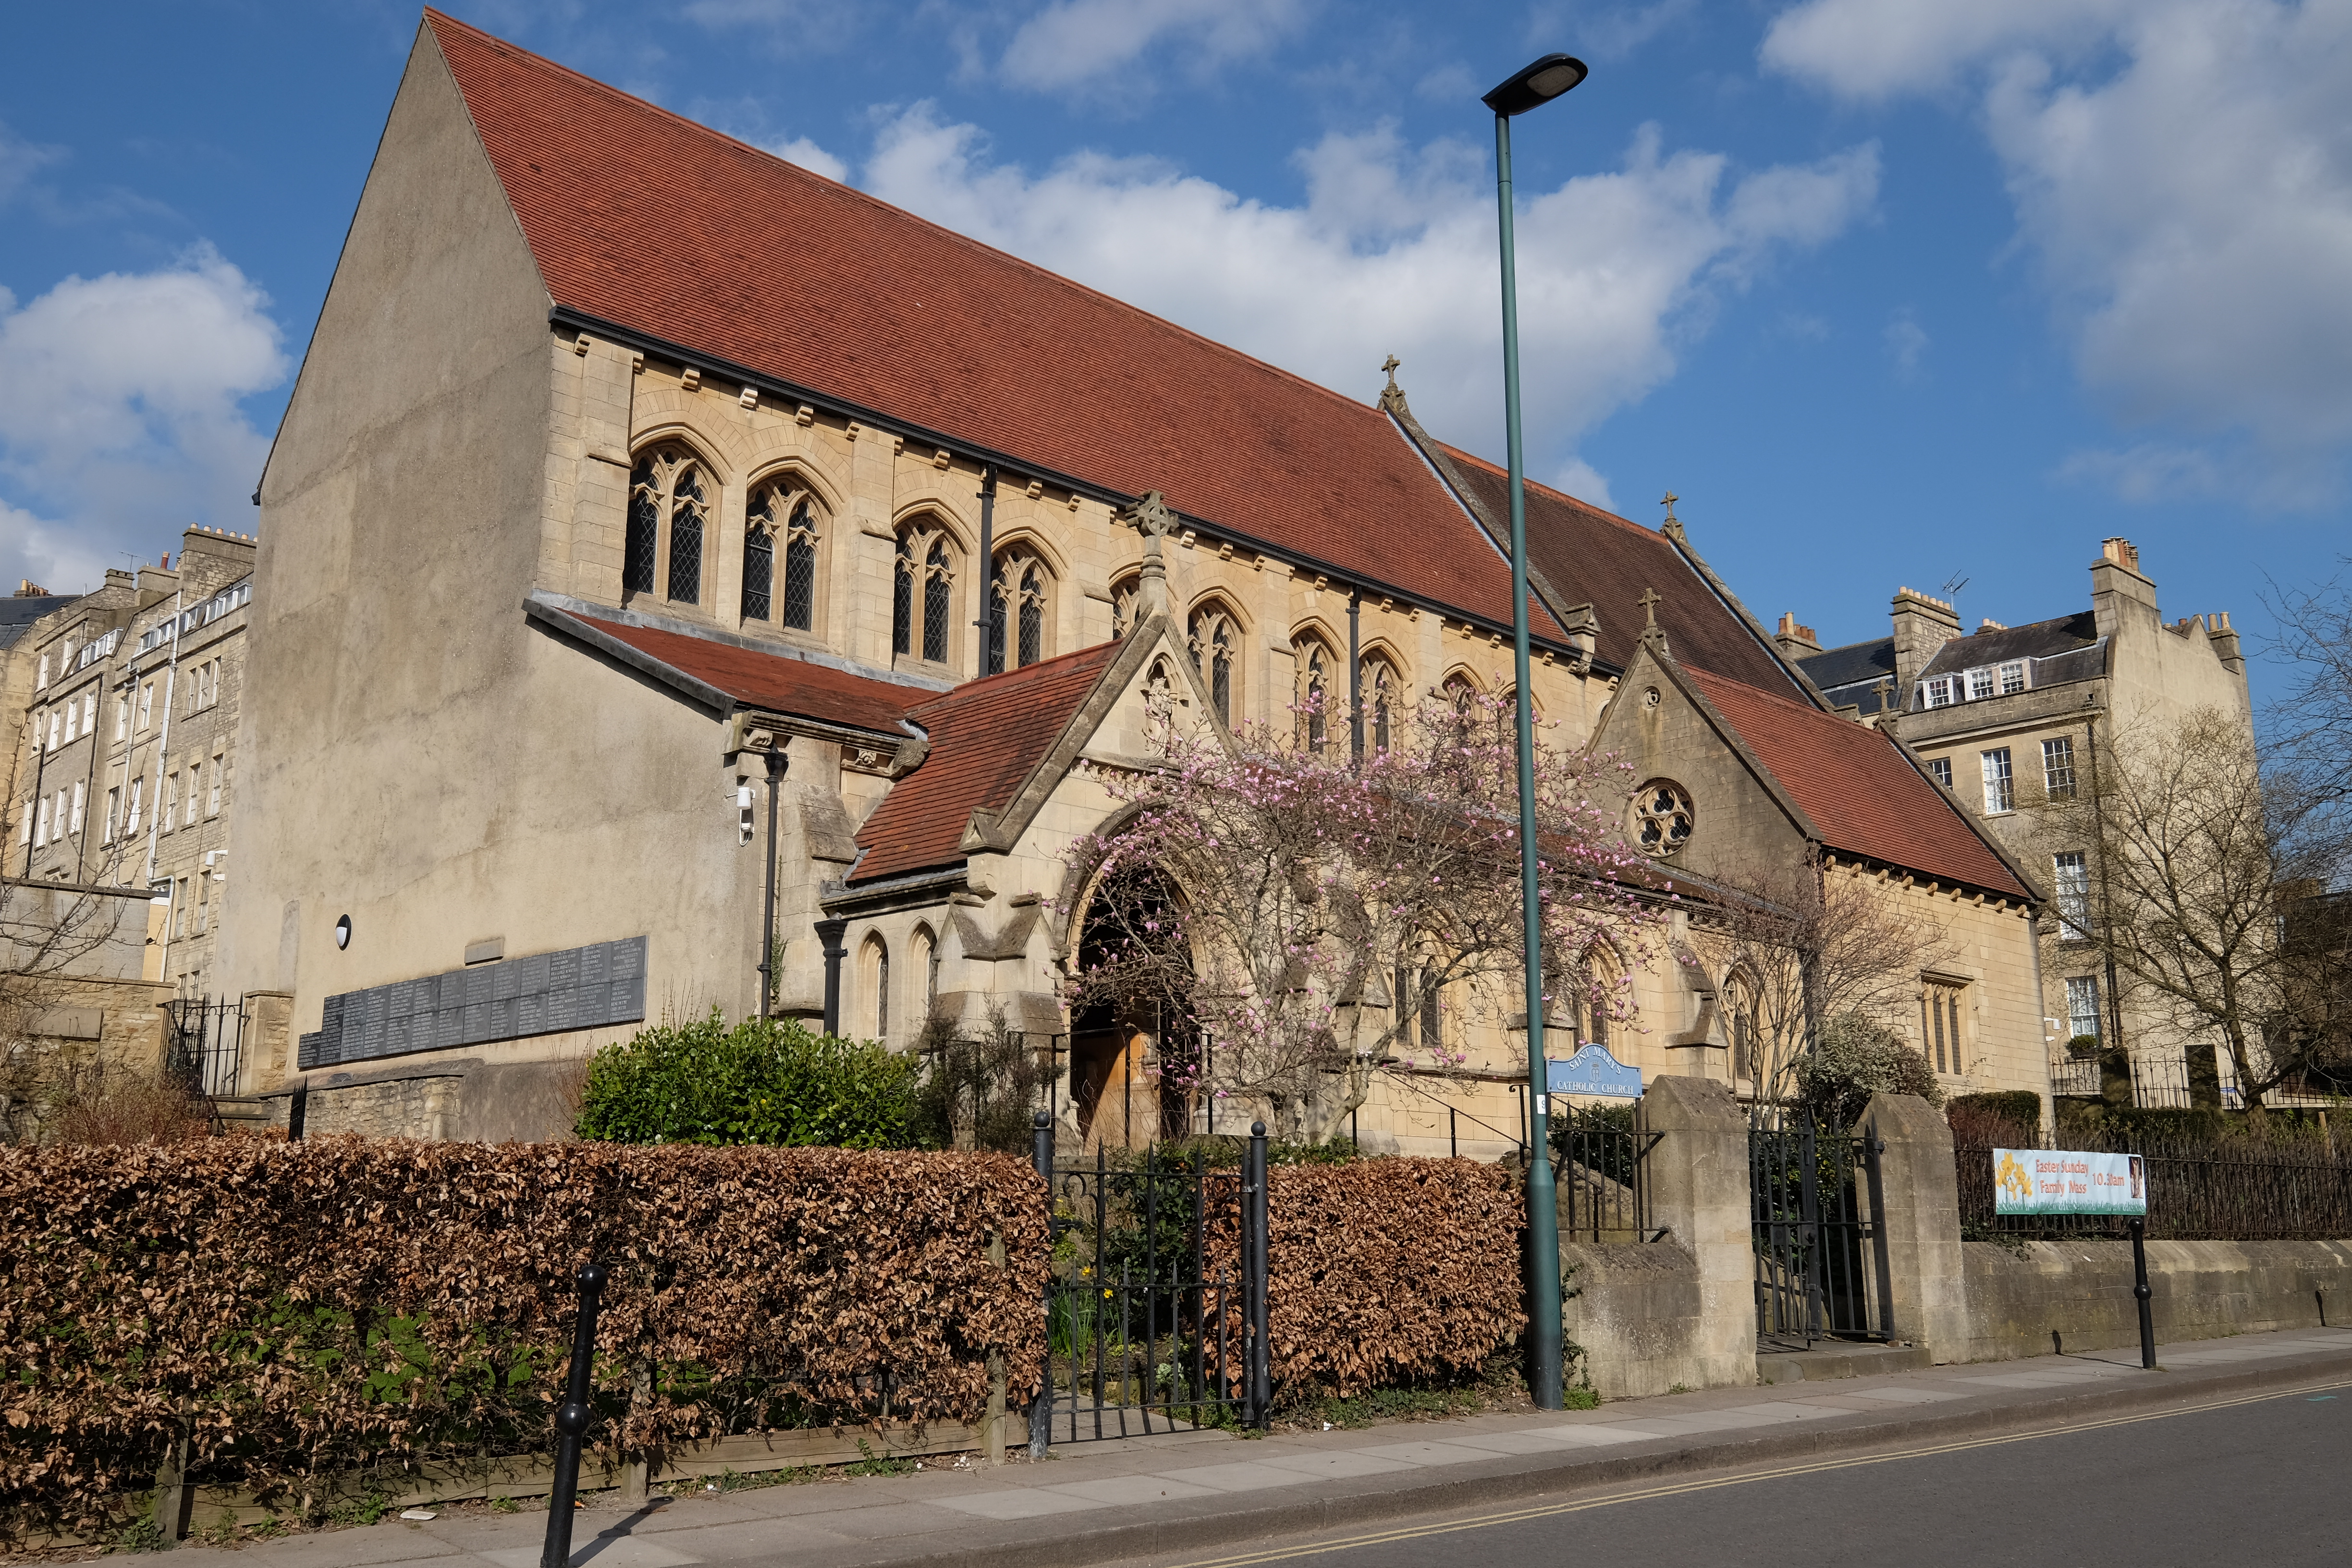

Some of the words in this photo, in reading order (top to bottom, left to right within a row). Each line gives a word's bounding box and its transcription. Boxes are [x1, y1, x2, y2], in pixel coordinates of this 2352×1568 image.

[1569, 1048, 1590, 1071] SAINT
[1557, 1081, 1596, 1092] CATHOLIC
[1601, 1084, 1633, 1095] CHURCH
[2035, 1159, 2059, 1173] Easter
[2060, 1159, 2089, 1177] Sunday
[2039, 1179, 2065, 1197] Family
